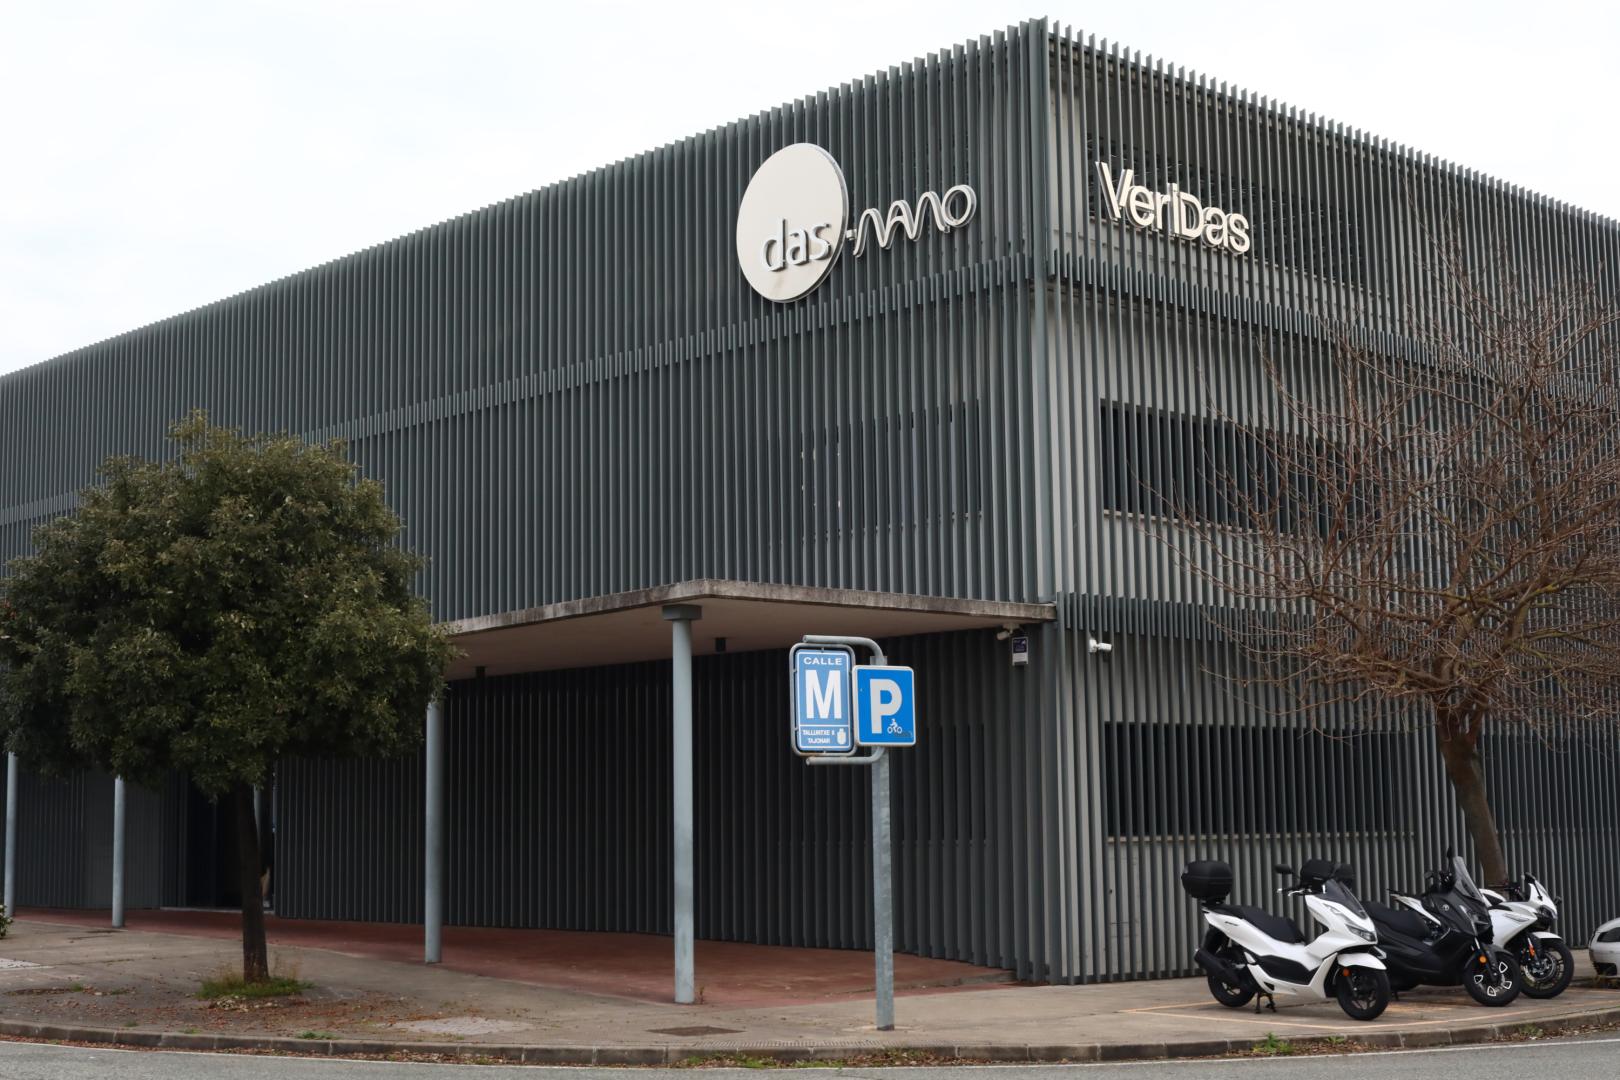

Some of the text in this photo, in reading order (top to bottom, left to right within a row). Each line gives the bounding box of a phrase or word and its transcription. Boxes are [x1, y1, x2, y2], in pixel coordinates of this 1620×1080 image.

[1095, 161, 1251, 256] VeriDas
[803, 656, 843, 665] CALLE
[804, 669, 842, 719] M
[869, 678, 903, 734] P
